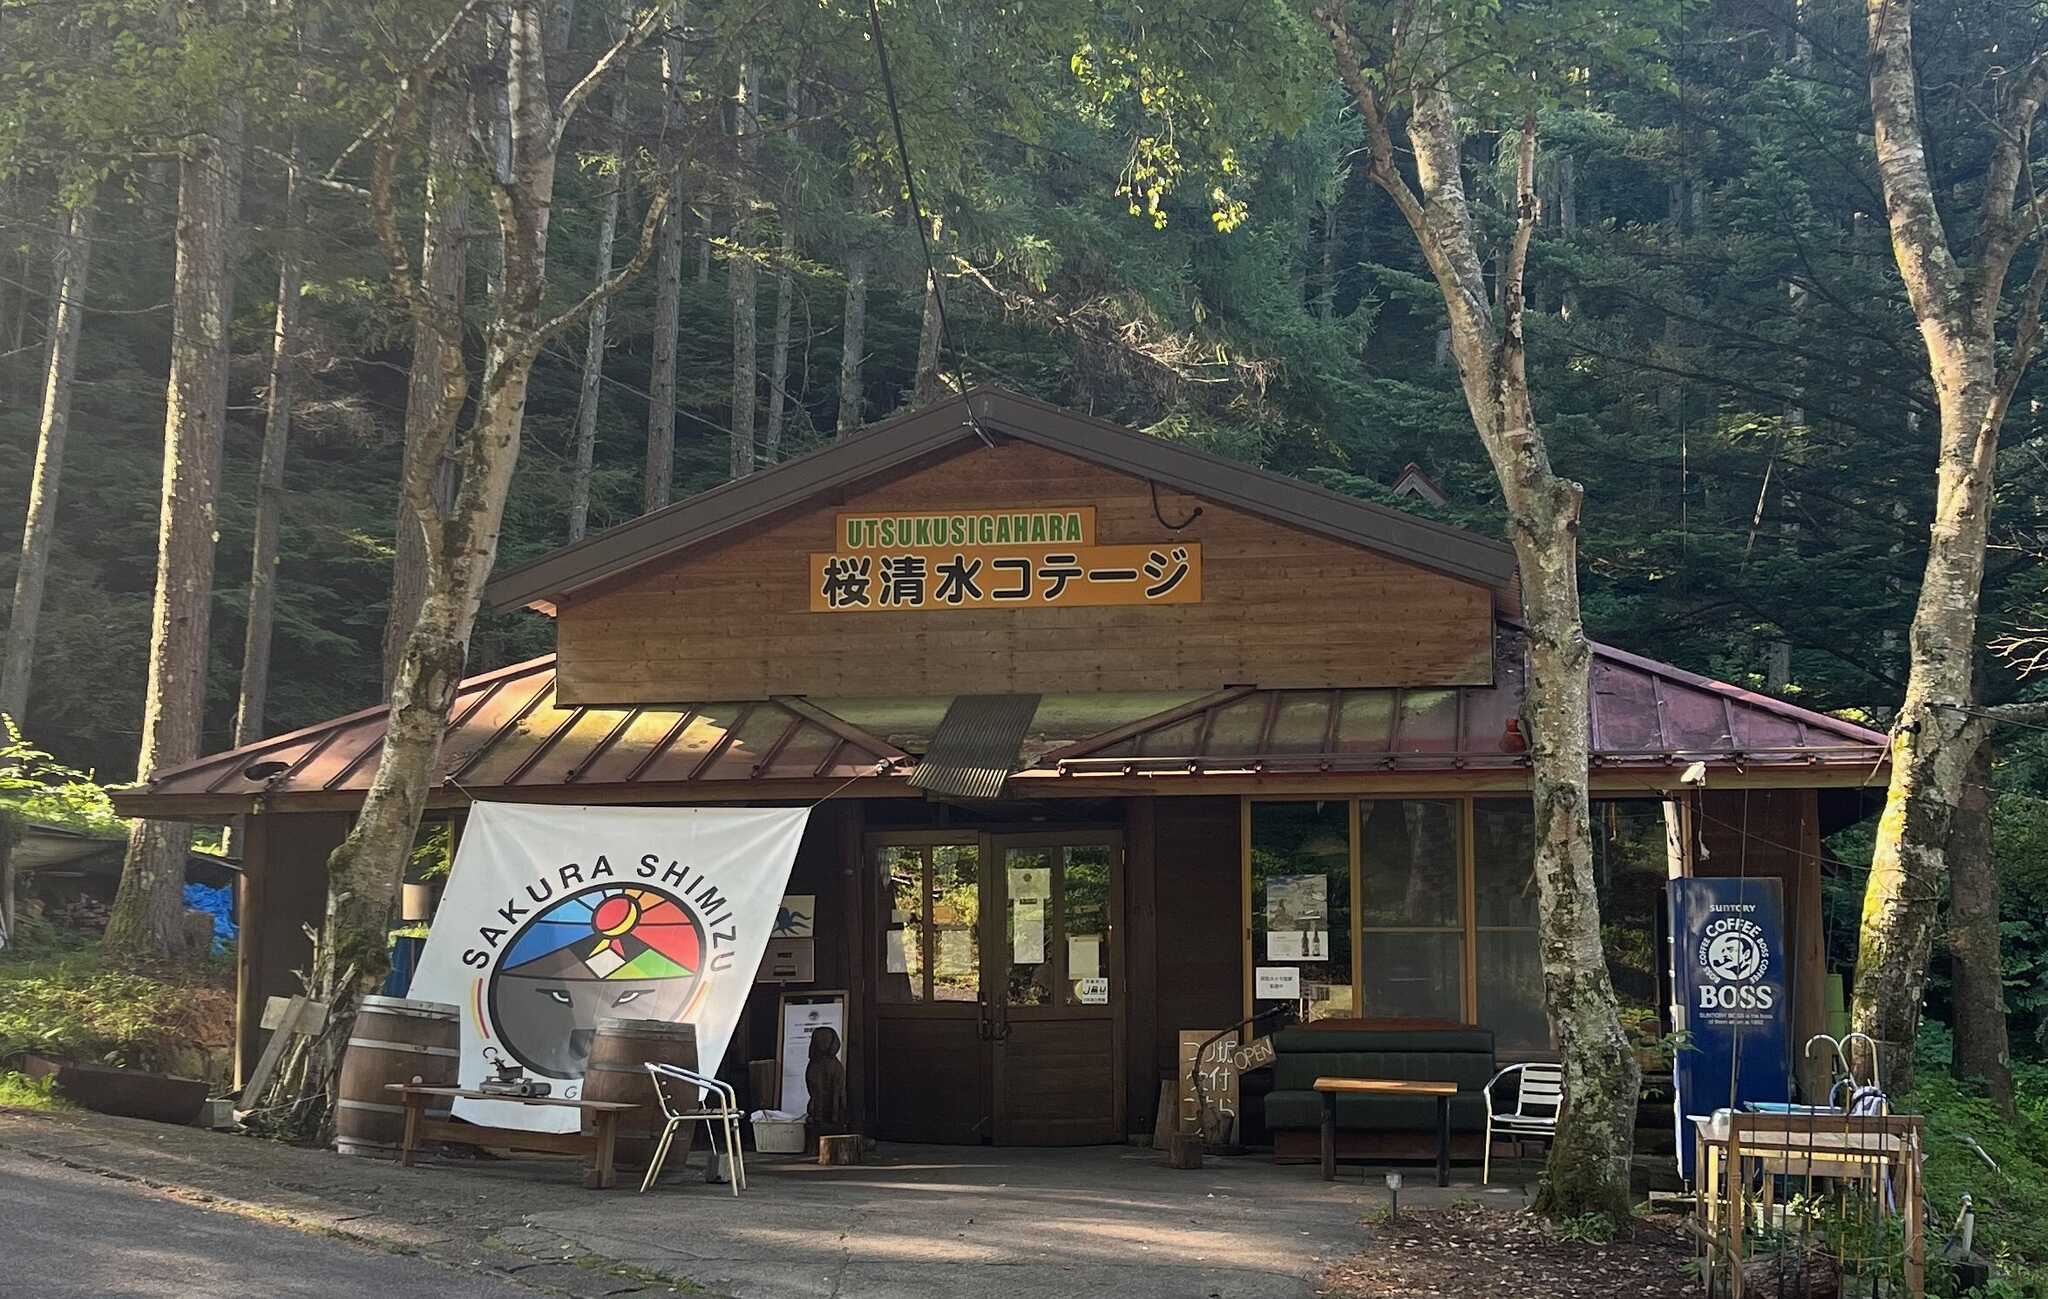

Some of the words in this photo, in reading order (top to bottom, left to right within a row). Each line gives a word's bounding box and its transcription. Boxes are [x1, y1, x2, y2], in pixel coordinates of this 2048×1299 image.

[846, 513, 1082, 548] UTSUKUSIGAHARA
[821, 548, 1189, 608] 桜清水コテージ
[462, 855, 614, 970] SAKURA
[637, 854, 738, 973] SHIMIZU
[1709, 904, 1756, 913] SUNTORY
[1706, 917, 1762, 938] COFFEE
[1698, 985, 1773, 1009] BOSS
[1234, 1038, 1272, 1070] OPEN
